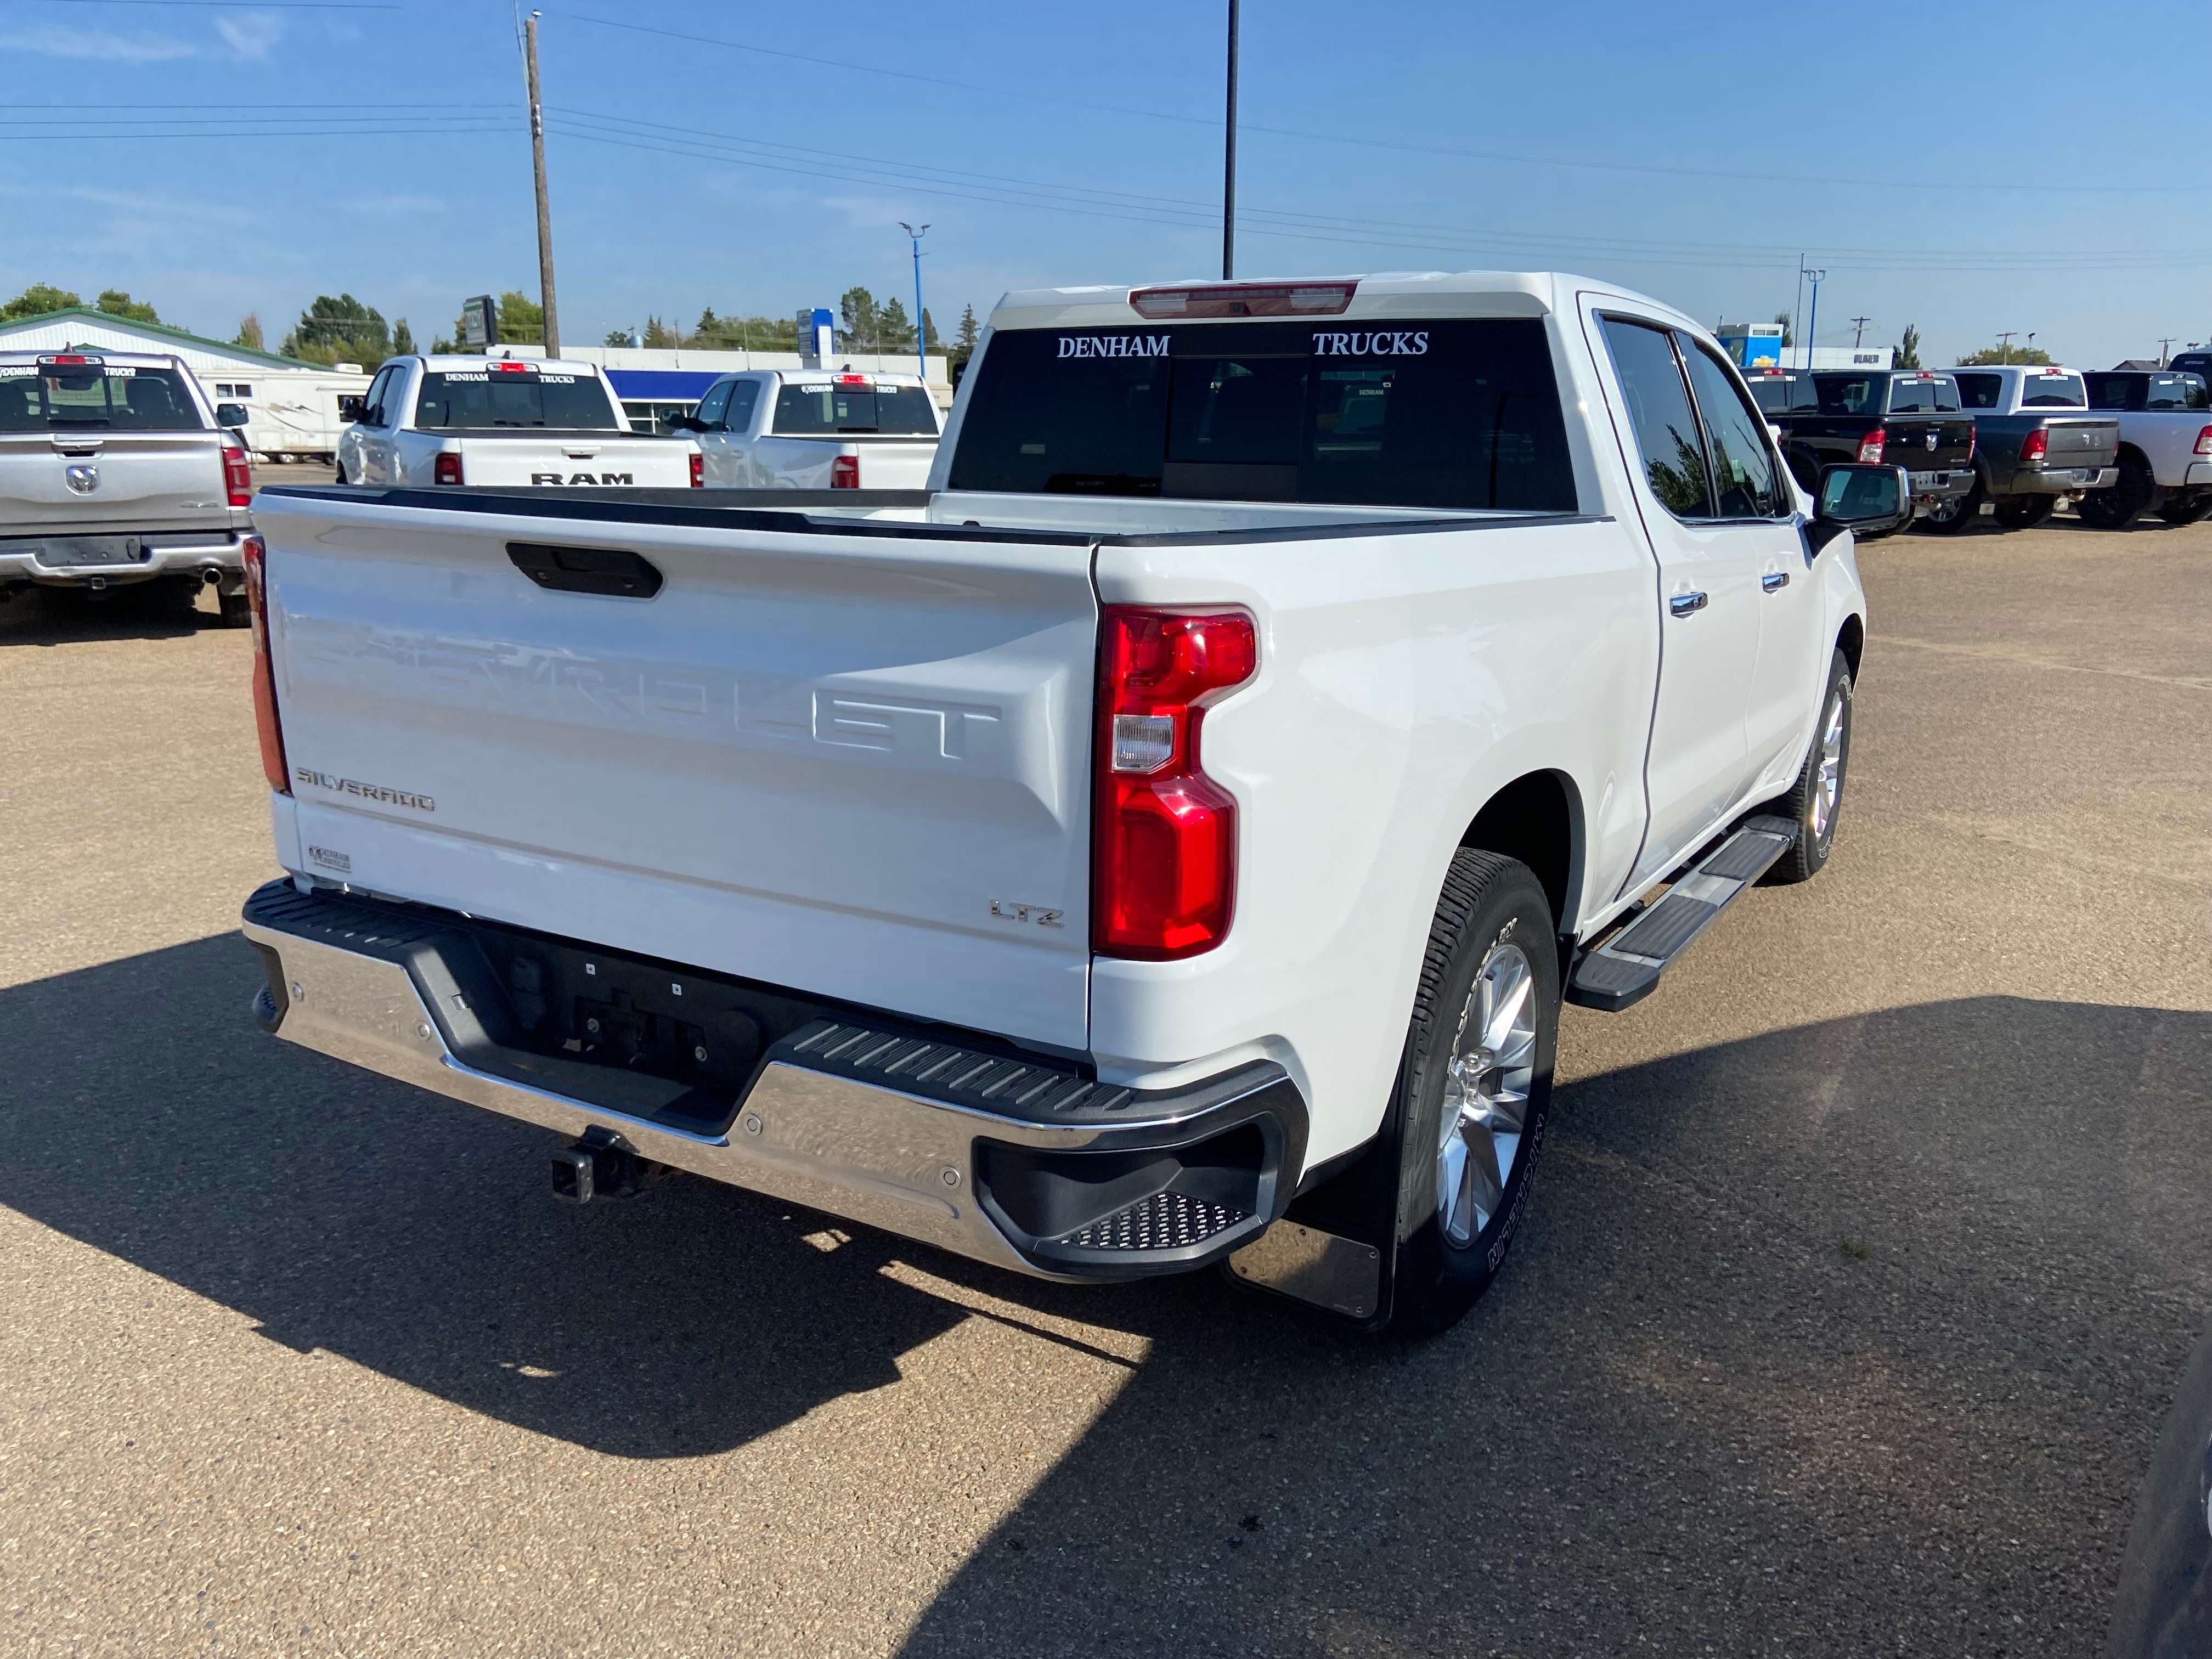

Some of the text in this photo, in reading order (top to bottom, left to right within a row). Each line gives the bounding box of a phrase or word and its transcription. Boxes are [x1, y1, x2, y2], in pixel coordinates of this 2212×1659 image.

[1057, 331, 1429, 358] DENHAM TRUCKS
[5, 366, 136, 377] DENHAM TRUCKS
[444, 373, 575, 383] DENHAM TRUCKS
[531, 473, 634, 486] RAM
[295, 766, 436, 812] SILVERADO
[990, 899, 1065, 927] LTZ
[1487, 1113, 1545, 1272] MICHELIN
